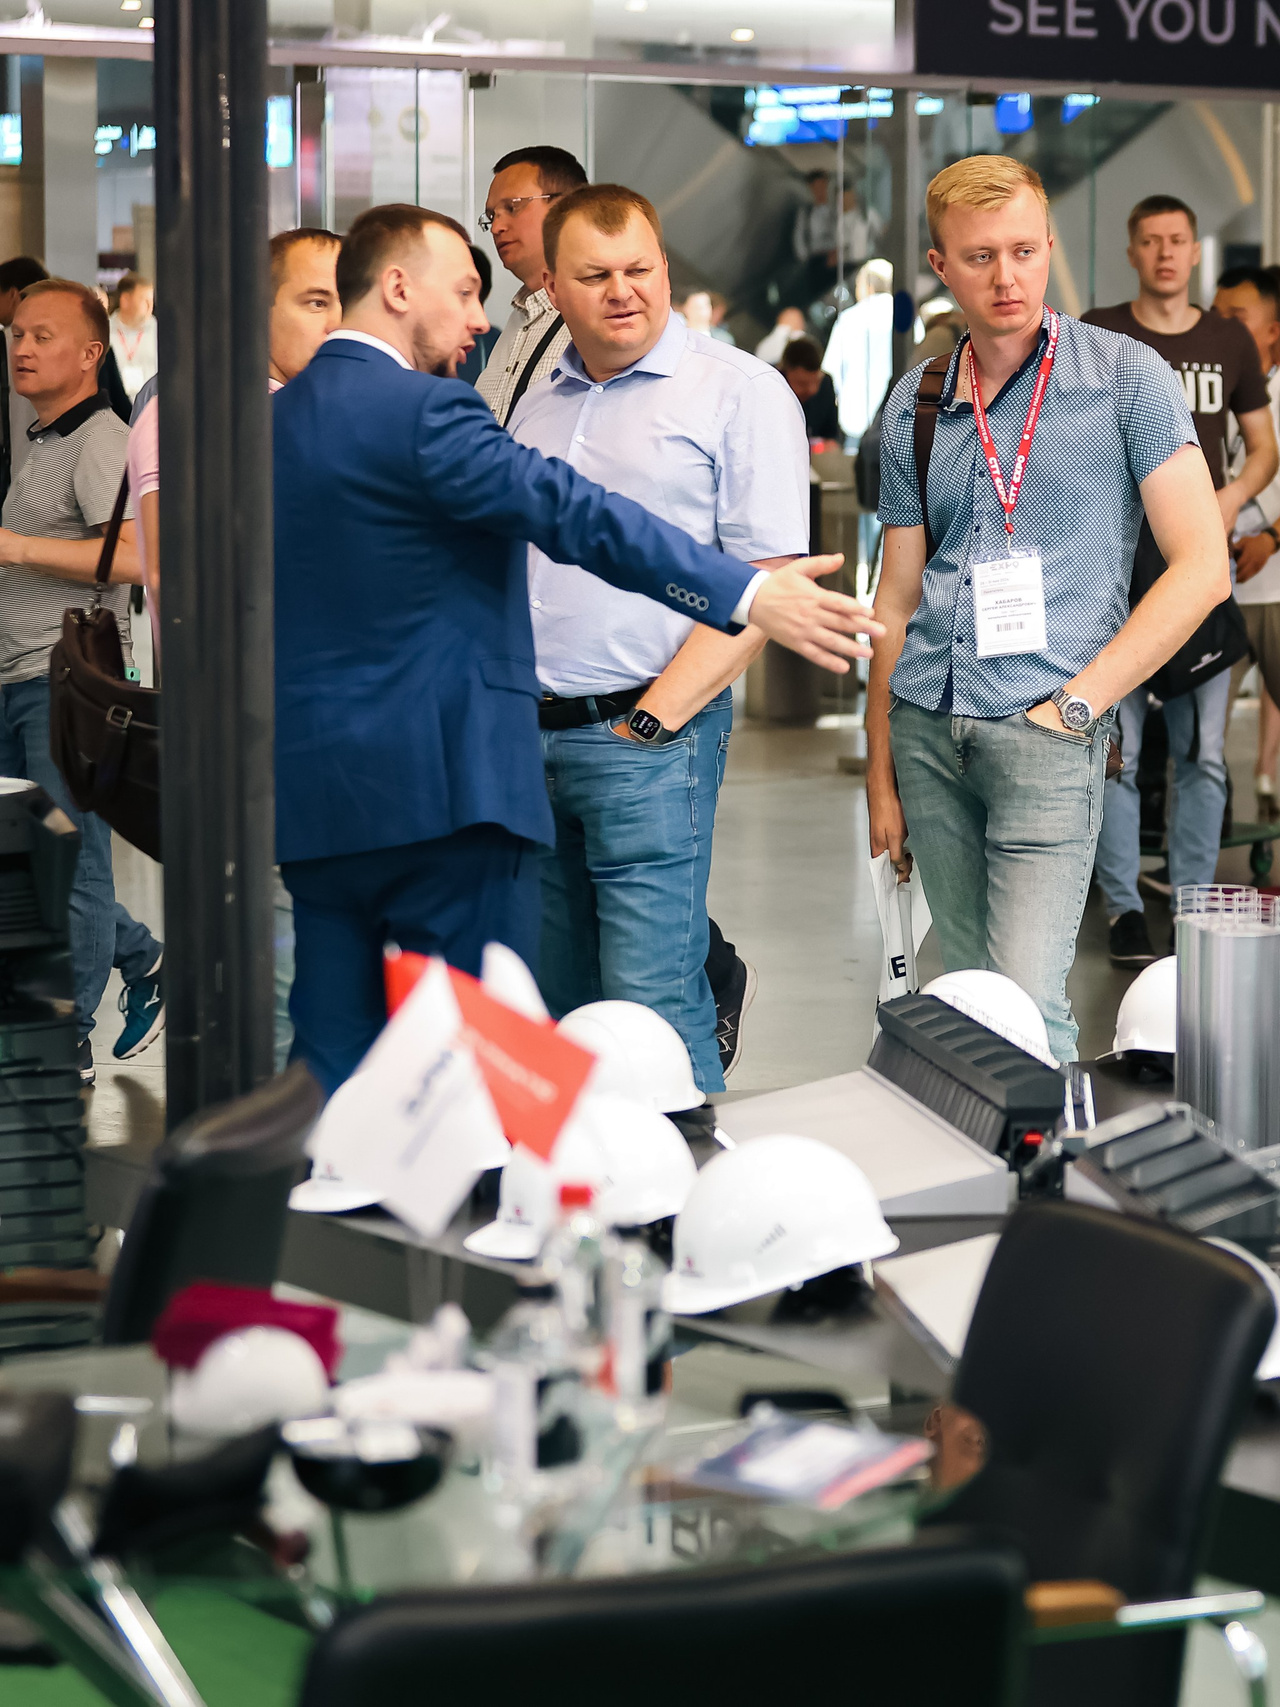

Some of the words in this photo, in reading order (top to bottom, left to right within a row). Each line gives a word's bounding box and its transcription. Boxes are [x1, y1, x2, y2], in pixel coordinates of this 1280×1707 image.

[988, 0, 1099, 37] SEE
[1117, 0, 1236, 43] YOU
[1045, 339, 1057, 359] CTT
[1026, 407, 1036, 431] TURKISH
[1033, 373, 1046, 407] MACHINERY
[988, 457, 1000, 475] CTT
[995, 477, 1008, 503] EXPO
[1013, 455, 1025, 483] EXPO
[1009, 484, 1018, 504] CTT
